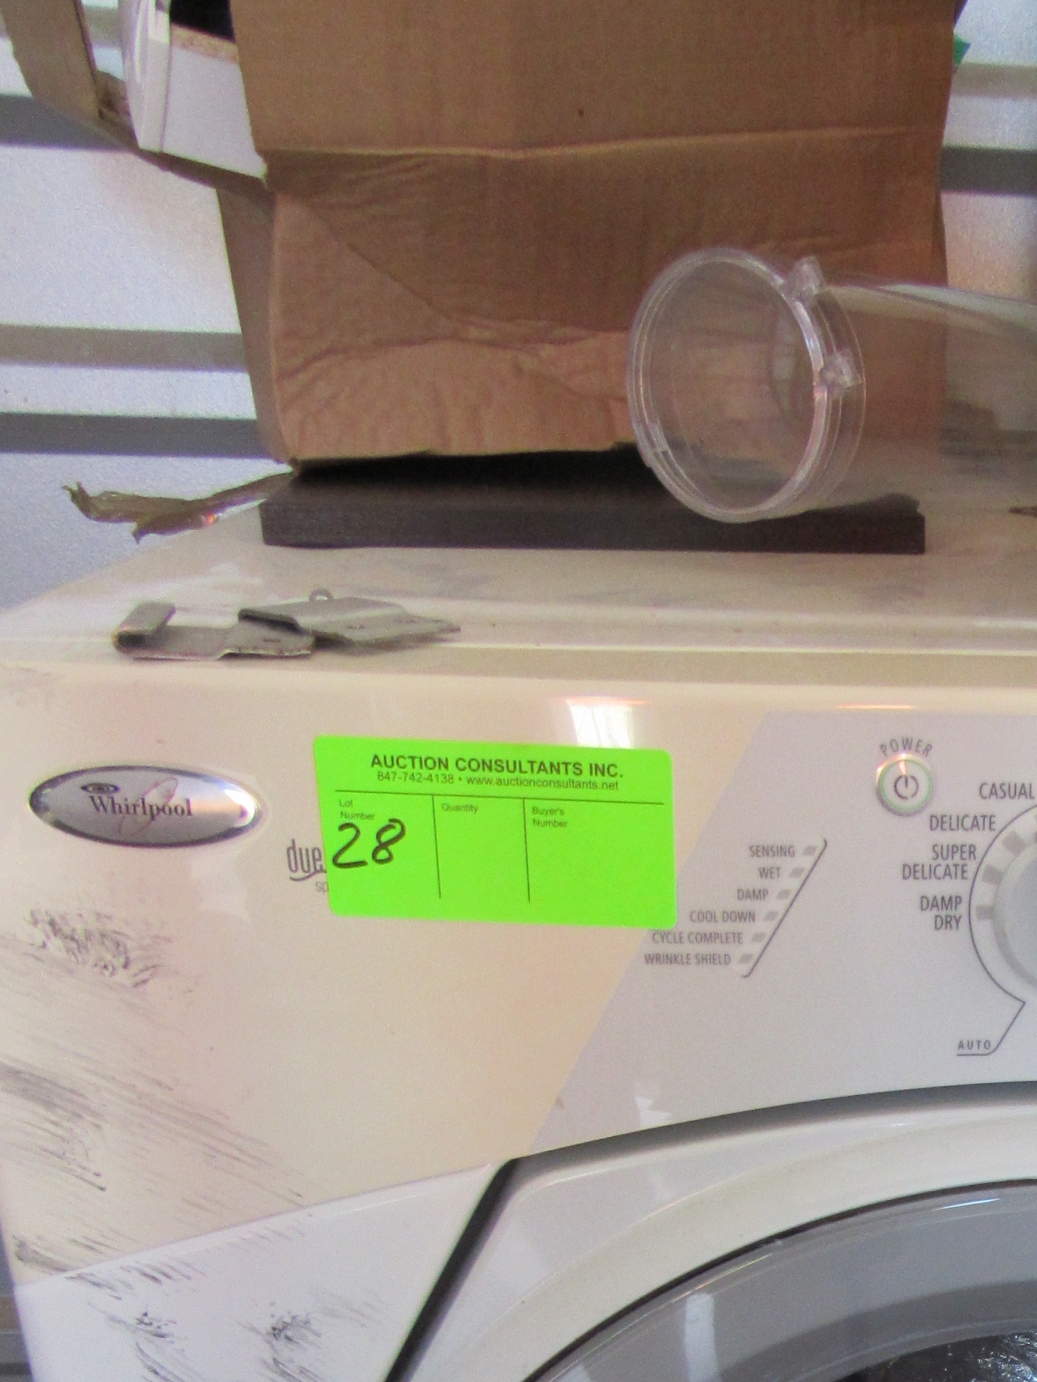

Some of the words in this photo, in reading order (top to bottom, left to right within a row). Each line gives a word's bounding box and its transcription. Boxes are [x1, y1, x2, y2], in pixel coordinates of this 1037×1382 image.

[879, 737, 933, 758] POWER
[371, 754, 450, 772] AUCTION
[455, 757, 584, 777] CONSULTANTS
[588, 762, 624, 778] INC.
[377, 771, 455, 785] 847-742-4138
[466, 775, 619, 791] www.auctionconsultants.net
[979, 782, 1035, 800] CASUAL
[89, 795, 193, 821] Whirlpool
[339, 799, 354, 809] Lot
[441, 803, 479, 815] Quantity
[532, 806, 565, 817] Buyer's
[340, 811, 376, 821] Number
[532, 818, 568, 828] Number
[929, 814, 996, 832] DELICATE
[331, 817, 407, 869] 28
[286, 838, 327, 876] due
[749, 845, 795, 858] SENSING
[932, 844, 977, 861] SUPER
[758, 867, 781, 879] WET
[902, 863, 969, 880] DELICATE
[737, 888, 769, 901] DAMP
[920, 896, 963, 912] DAMP
[690, 910, 718, 923] COOL
[722, 911, 756, 923] DOWN
[934, 914, 963, 931] DRY
[652, 931, 684, 944] CYCLE
[688, 932, 743, 945] COMPLETE
[644, 953, 691, 966] WRINKLE
[695, 953, 731, 966] SHIELD
[957, 1039, 992, 1051] AUTO
